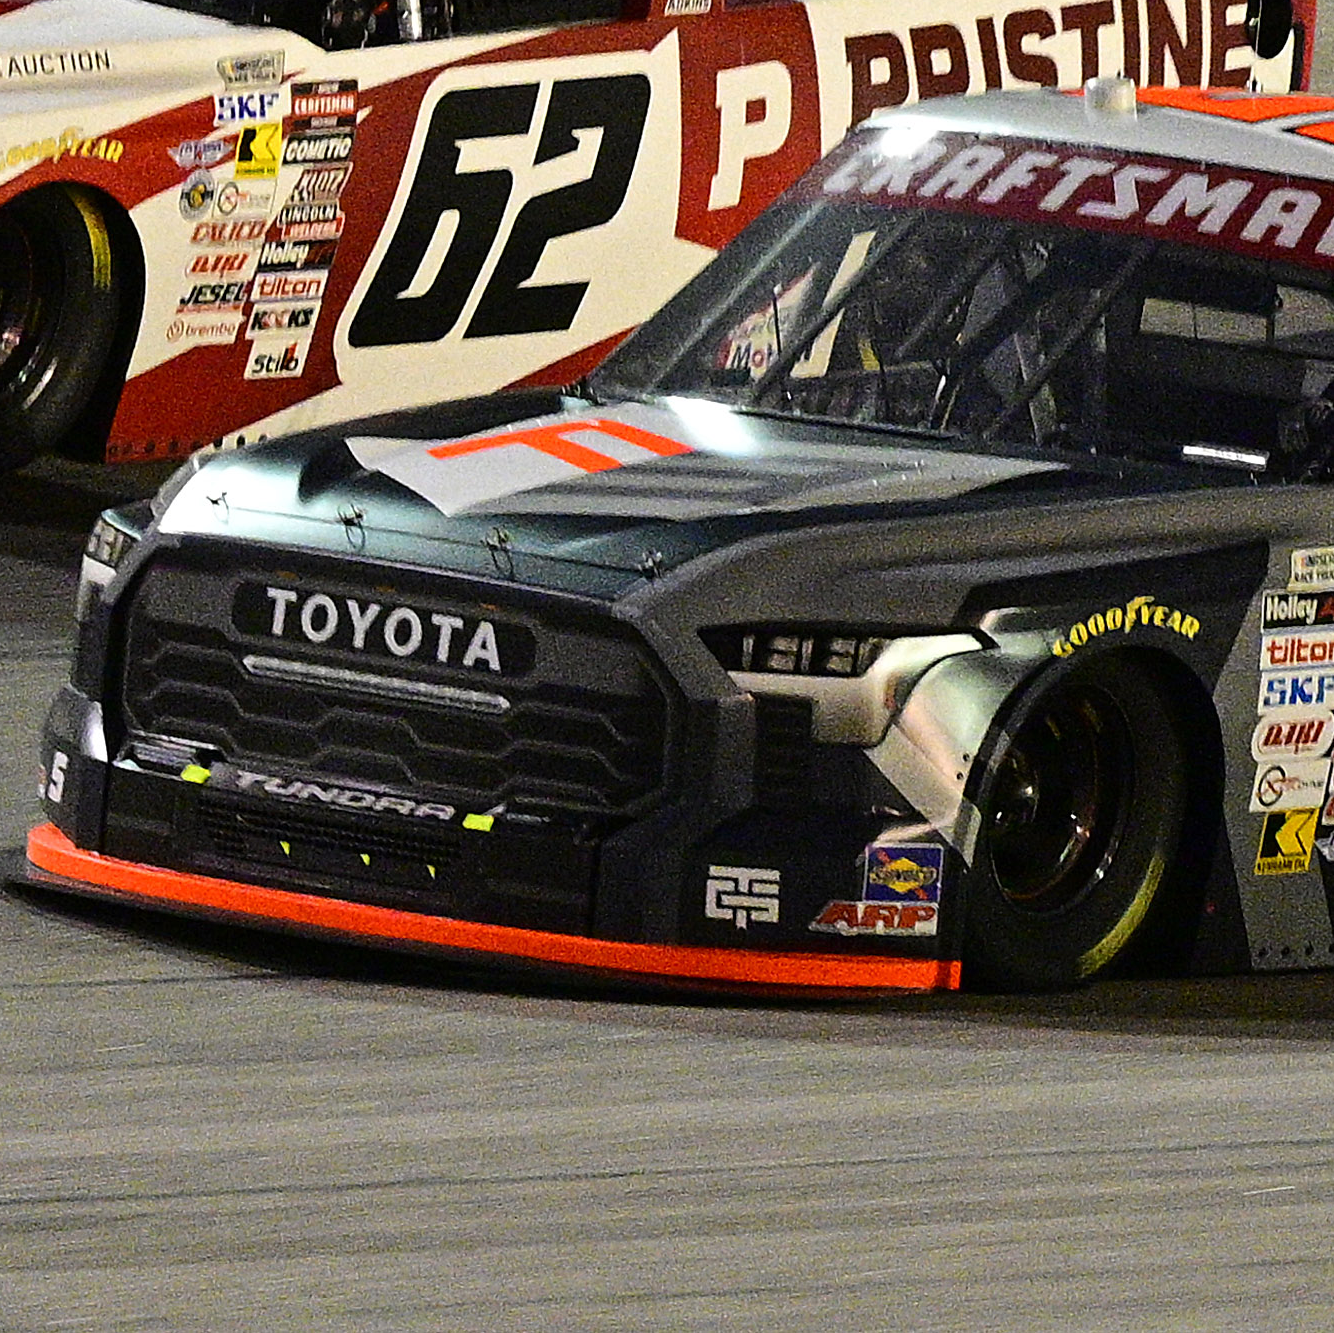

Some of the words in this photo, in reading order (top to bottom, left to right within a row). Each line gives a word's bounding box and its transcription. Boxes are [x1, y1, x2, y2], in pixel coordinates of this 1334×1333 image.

[7, 49, 111, 78] AUCTION
[218, 93, 279, 121] SKF
[348, 73, 651, 347] 62
[261, 242, 309, 268] Holley
[180, 282, 246, 304] JESEL
[260, 278, 320, 296] tilton
[186, 323, 236, 337] brembo
[1266, 594, 1317, 625] Holley
[267, 586, 501, 671] TOYOTA
[1053, 596, 1200, 657] GOODYEAR
